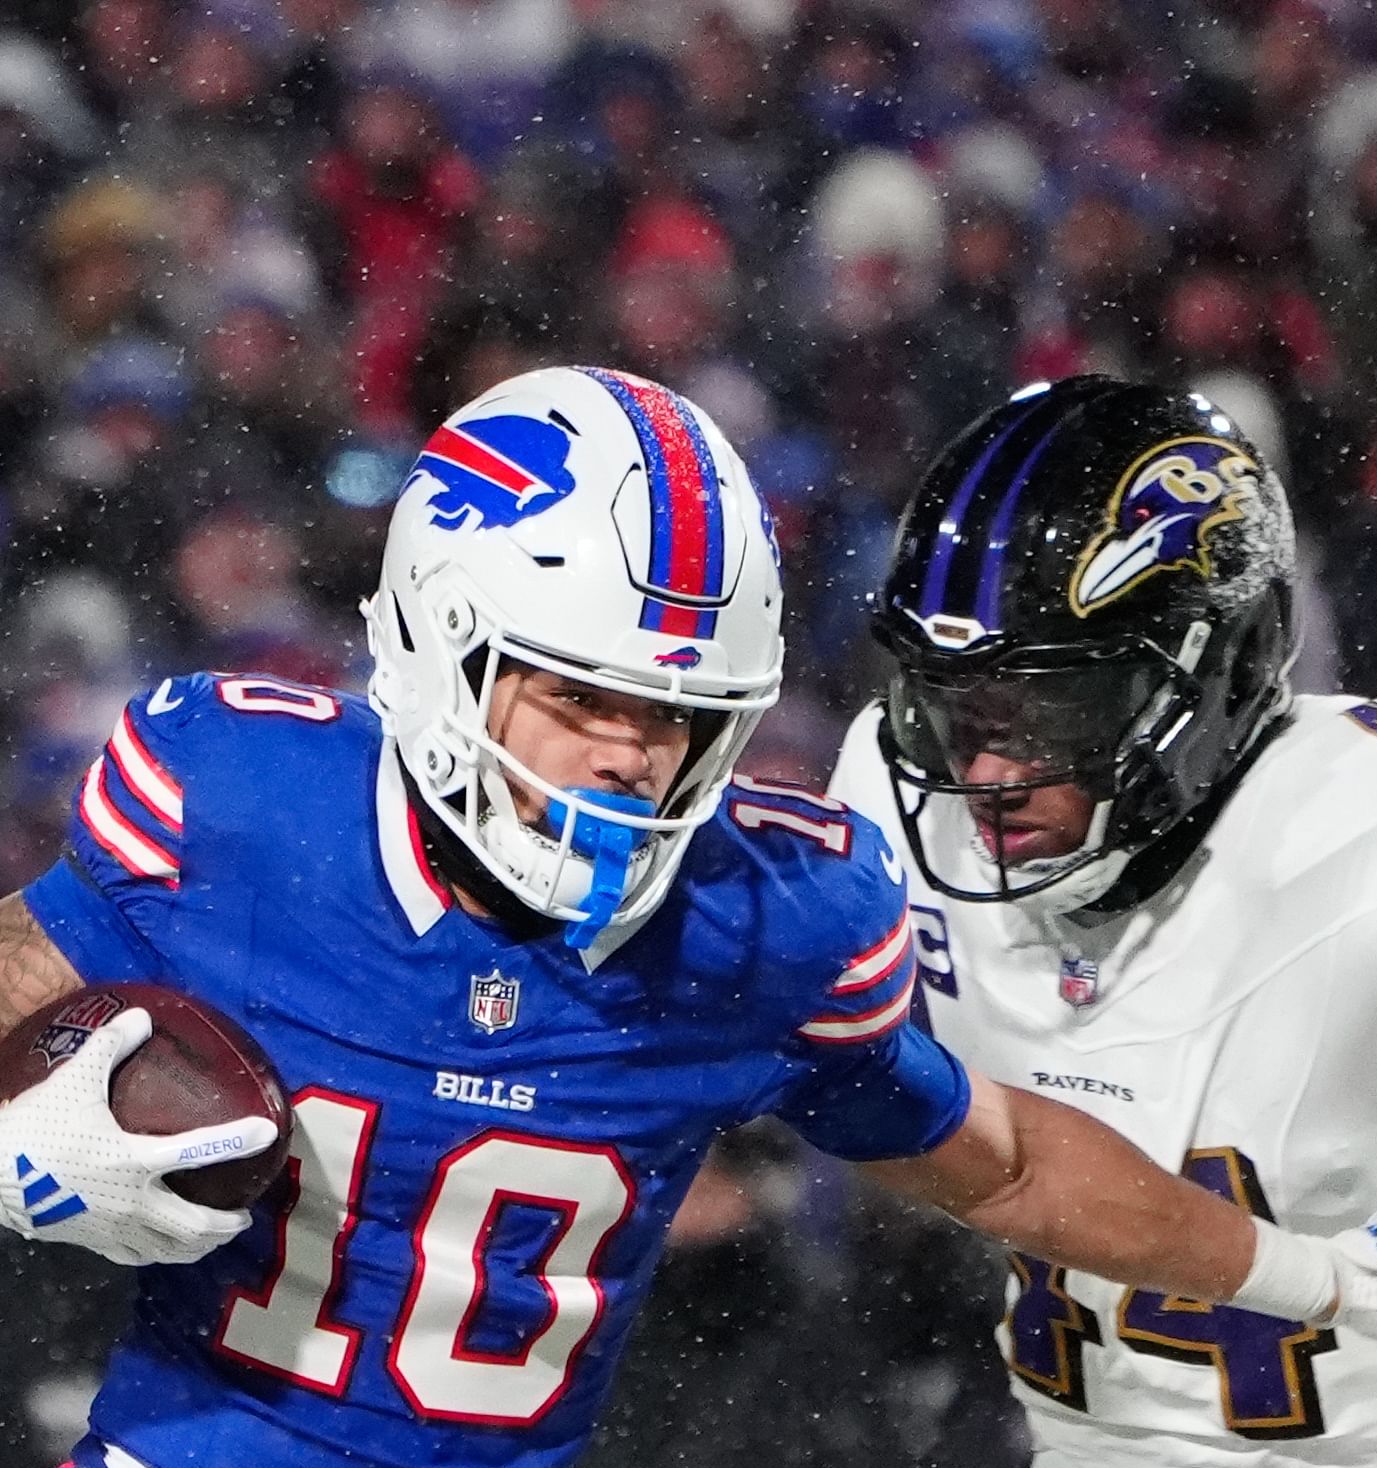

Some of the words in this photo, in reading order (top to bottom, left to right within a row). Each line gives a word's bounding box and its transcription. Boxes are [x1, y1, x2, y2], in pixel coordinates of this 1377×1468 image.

[210, 668, 344, 724] 0
[474, 999, 511, 1022] NFL
[435, 1071, 537, 1113] BILLS
[1031, 1072, 1135, 1103] RAVENS
[178, 1136, 244, 1163] ADIZERO
[216, 1084, 637, 1427] 10
